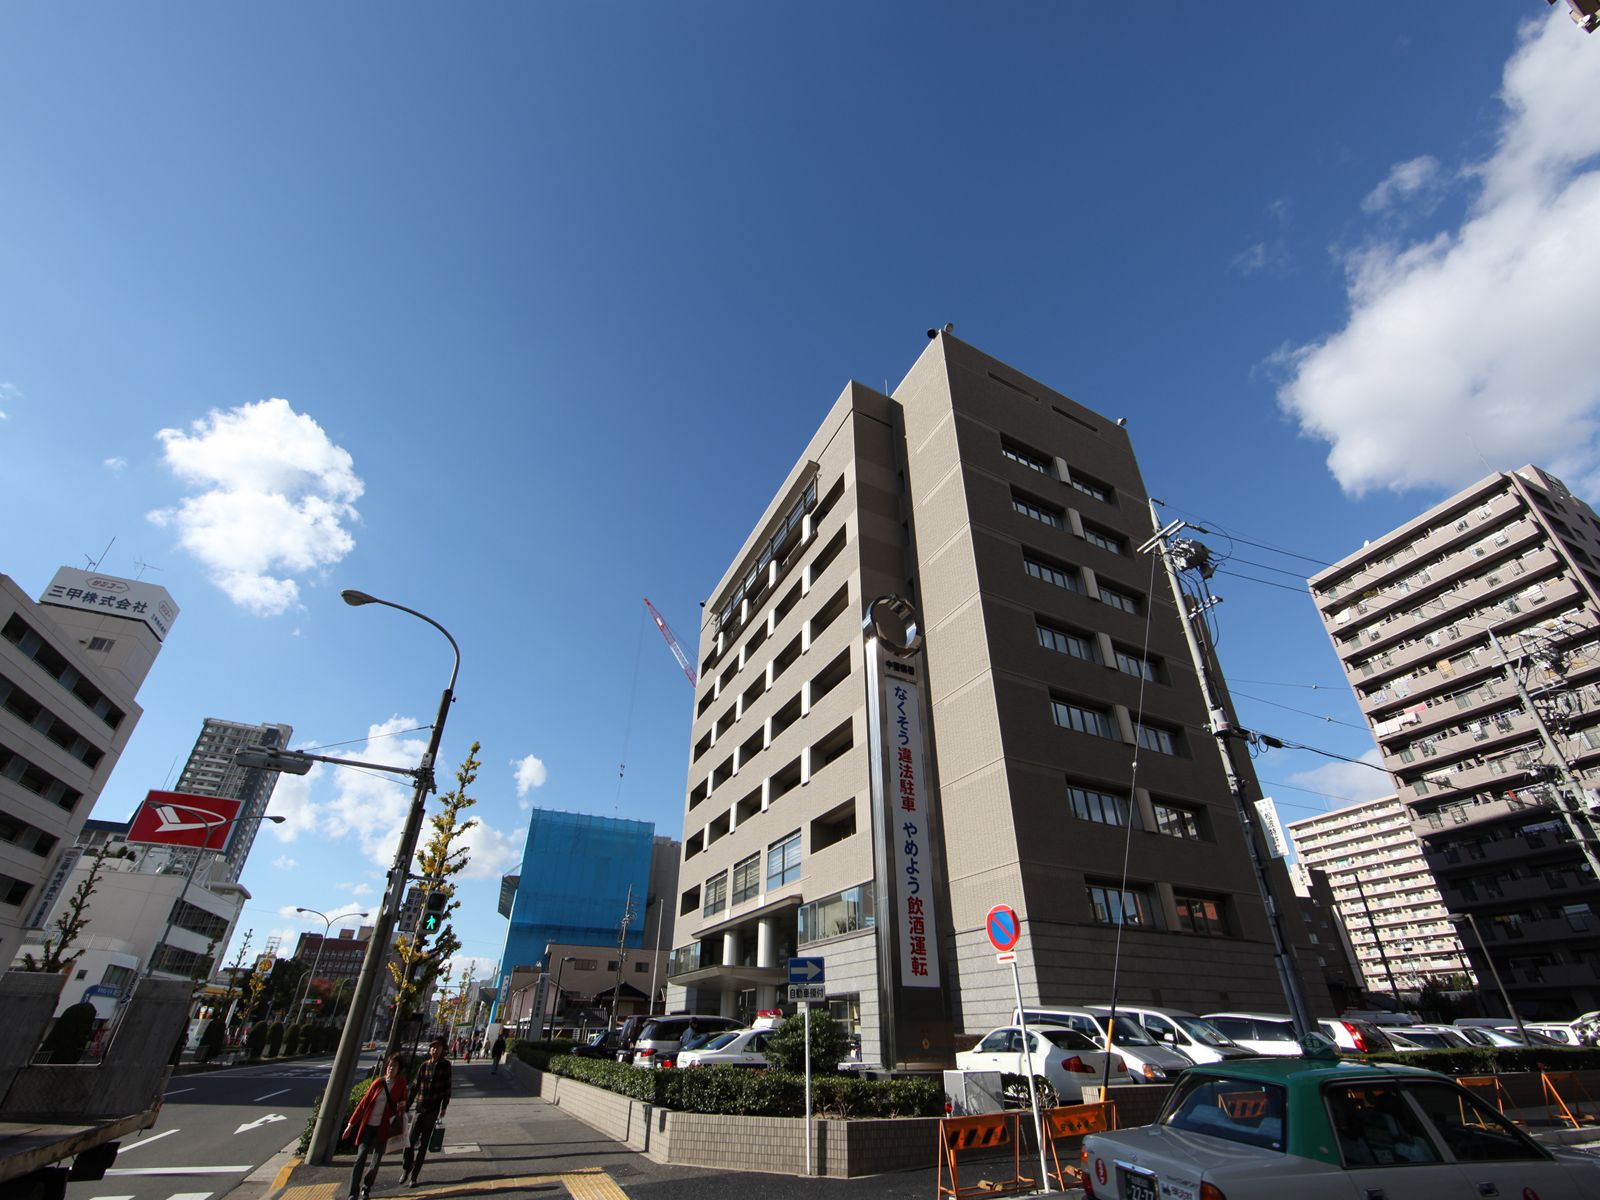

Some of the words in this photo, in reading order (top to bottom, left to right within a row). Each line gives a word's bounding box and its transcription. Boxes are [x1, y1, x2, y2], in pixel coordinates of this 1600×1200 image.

[47, 584, 149, 615] 三甲株式会社
[893, 685, 917, 813] なくそう違法駐車
[902, 821, 929, 977] やめよう飲酒運転
